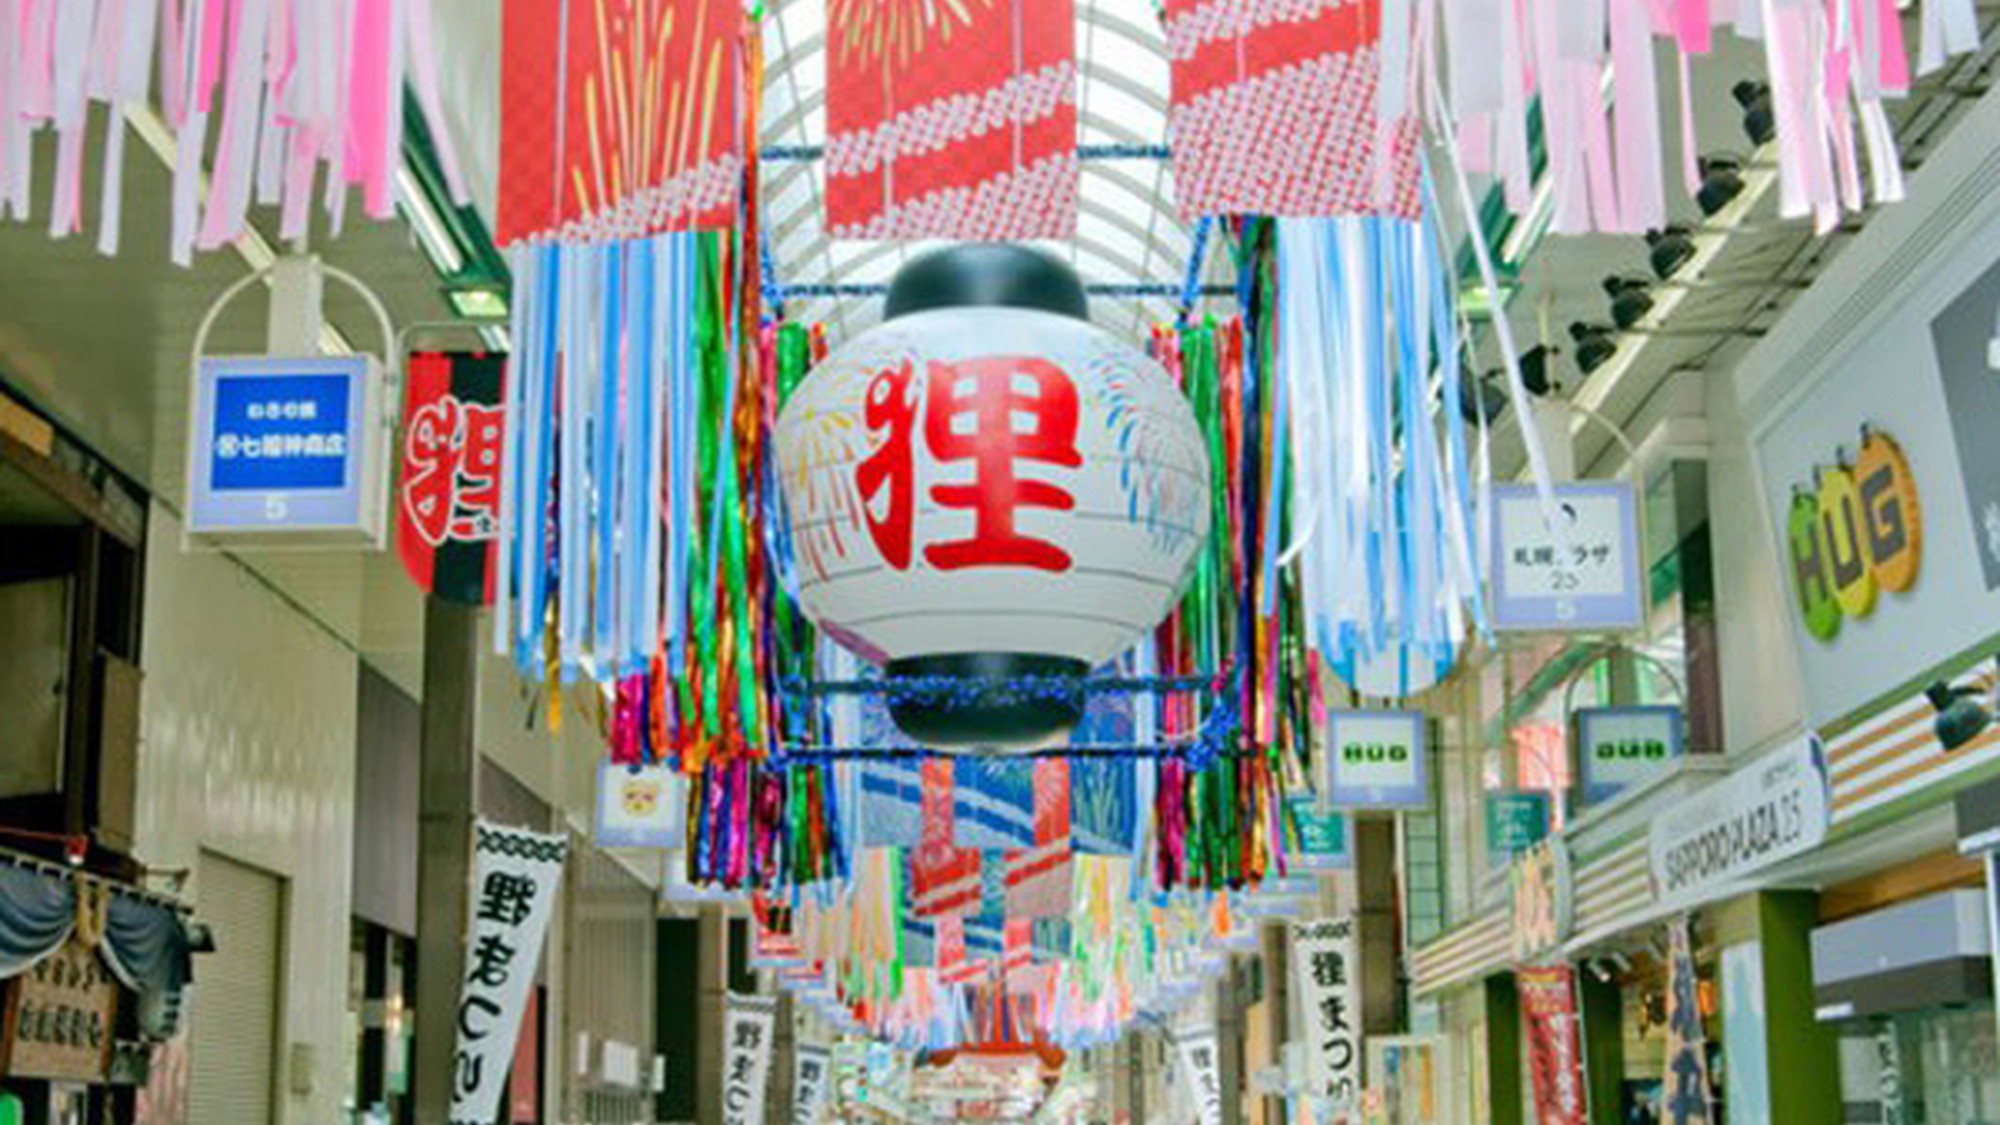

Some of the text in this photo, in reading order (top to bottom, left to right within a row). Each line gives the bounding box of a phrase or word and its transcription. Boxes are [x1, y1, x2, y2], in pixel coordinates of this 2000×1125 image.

[856, 358, 1083, 572] 狸
[1514, 545, 1609, 567] 札幌ラザ
[1793, 464, 1906, 613] HUG
[1344, 743, 1408, 763] HUG
